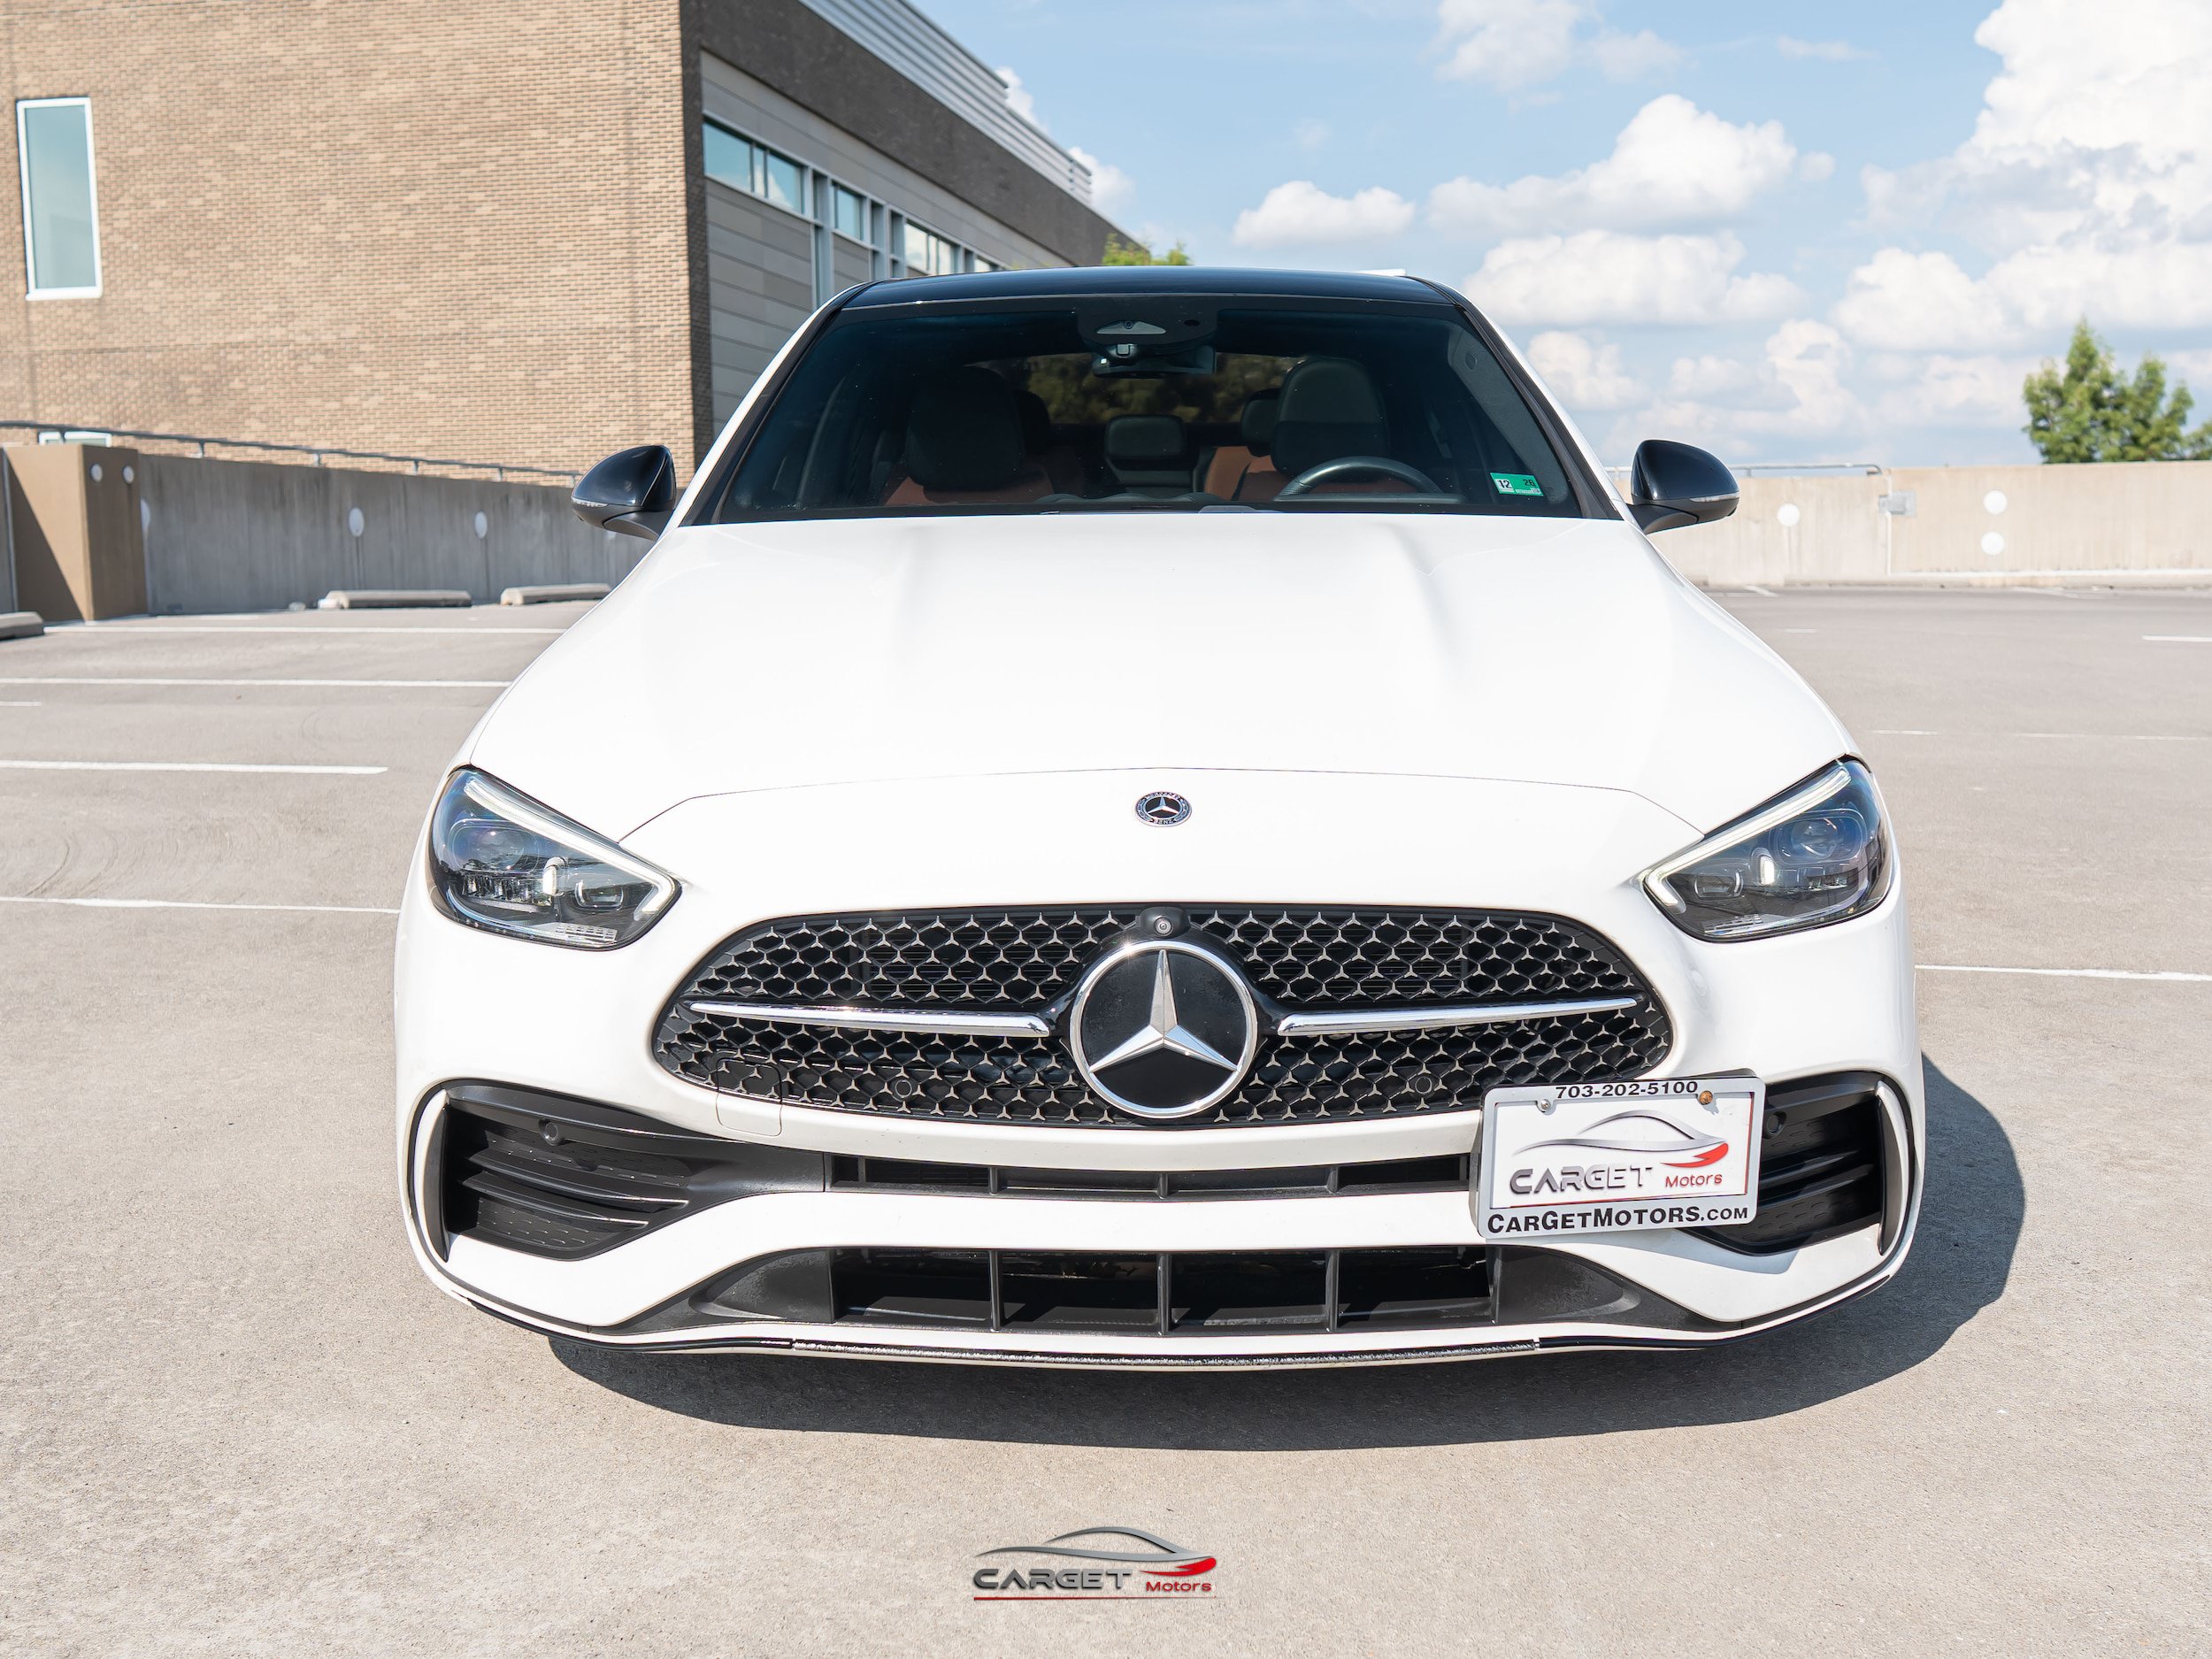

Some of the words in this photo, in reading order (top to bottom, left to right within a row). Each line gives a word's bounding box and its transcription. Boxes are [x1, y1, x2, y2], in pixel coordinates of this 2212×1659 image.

[1499, 480, 1510, 488] 12
[1556, 1081, 1699, 1099] 703-202-5100
[1509, 1164, 1653, 1194] CARGET
[1664, 1172, 1724, 1188] Motors
